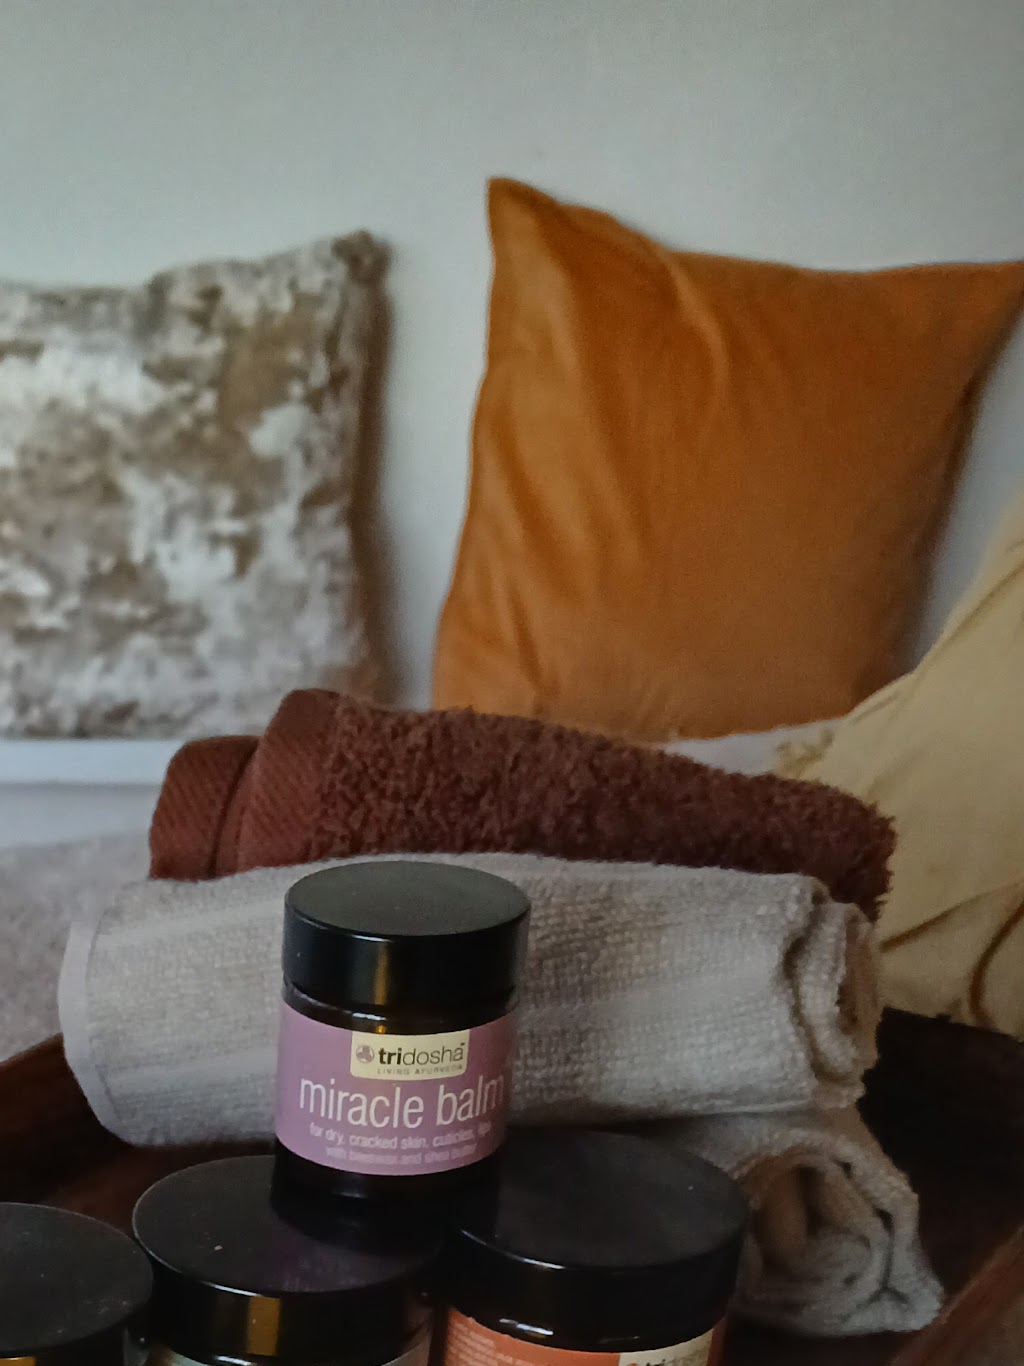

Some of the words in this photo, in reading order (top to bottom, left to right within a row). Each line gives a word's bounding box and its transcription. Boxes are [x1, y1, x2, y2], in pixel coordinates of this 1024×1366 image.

[378, 1045, 464, 1066] tridosha
[299, 1078, 425, 1129] miracle
[435, 1075, 504, 1127] balm
[349, 1134, 397, 1149] cracked
